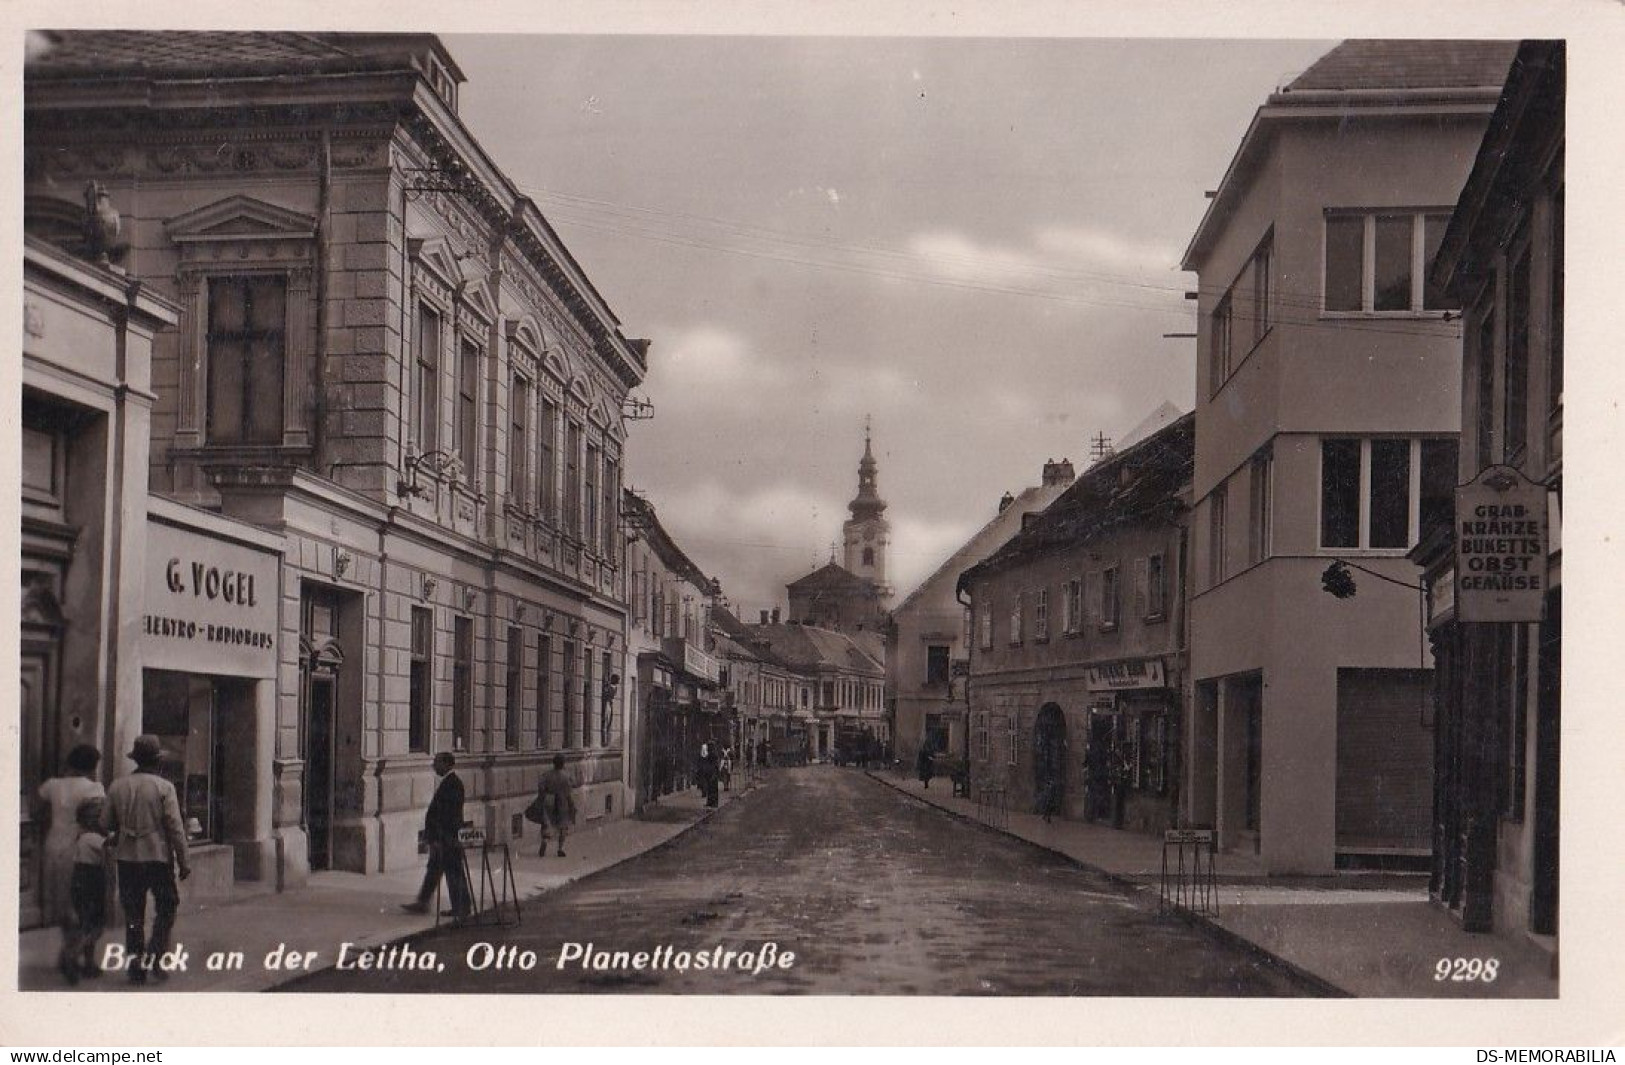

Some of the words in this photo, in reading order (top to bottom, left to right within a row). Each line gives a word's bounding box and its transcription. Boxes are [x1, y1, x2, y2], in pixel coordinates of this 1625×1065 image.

[1461, 539, 1541, 554] BUKETTS
[1468, 556, 1533, 571] OBST
[166, 558, 185, 593] G.
[192, 562, 258, 607] VOGEL
